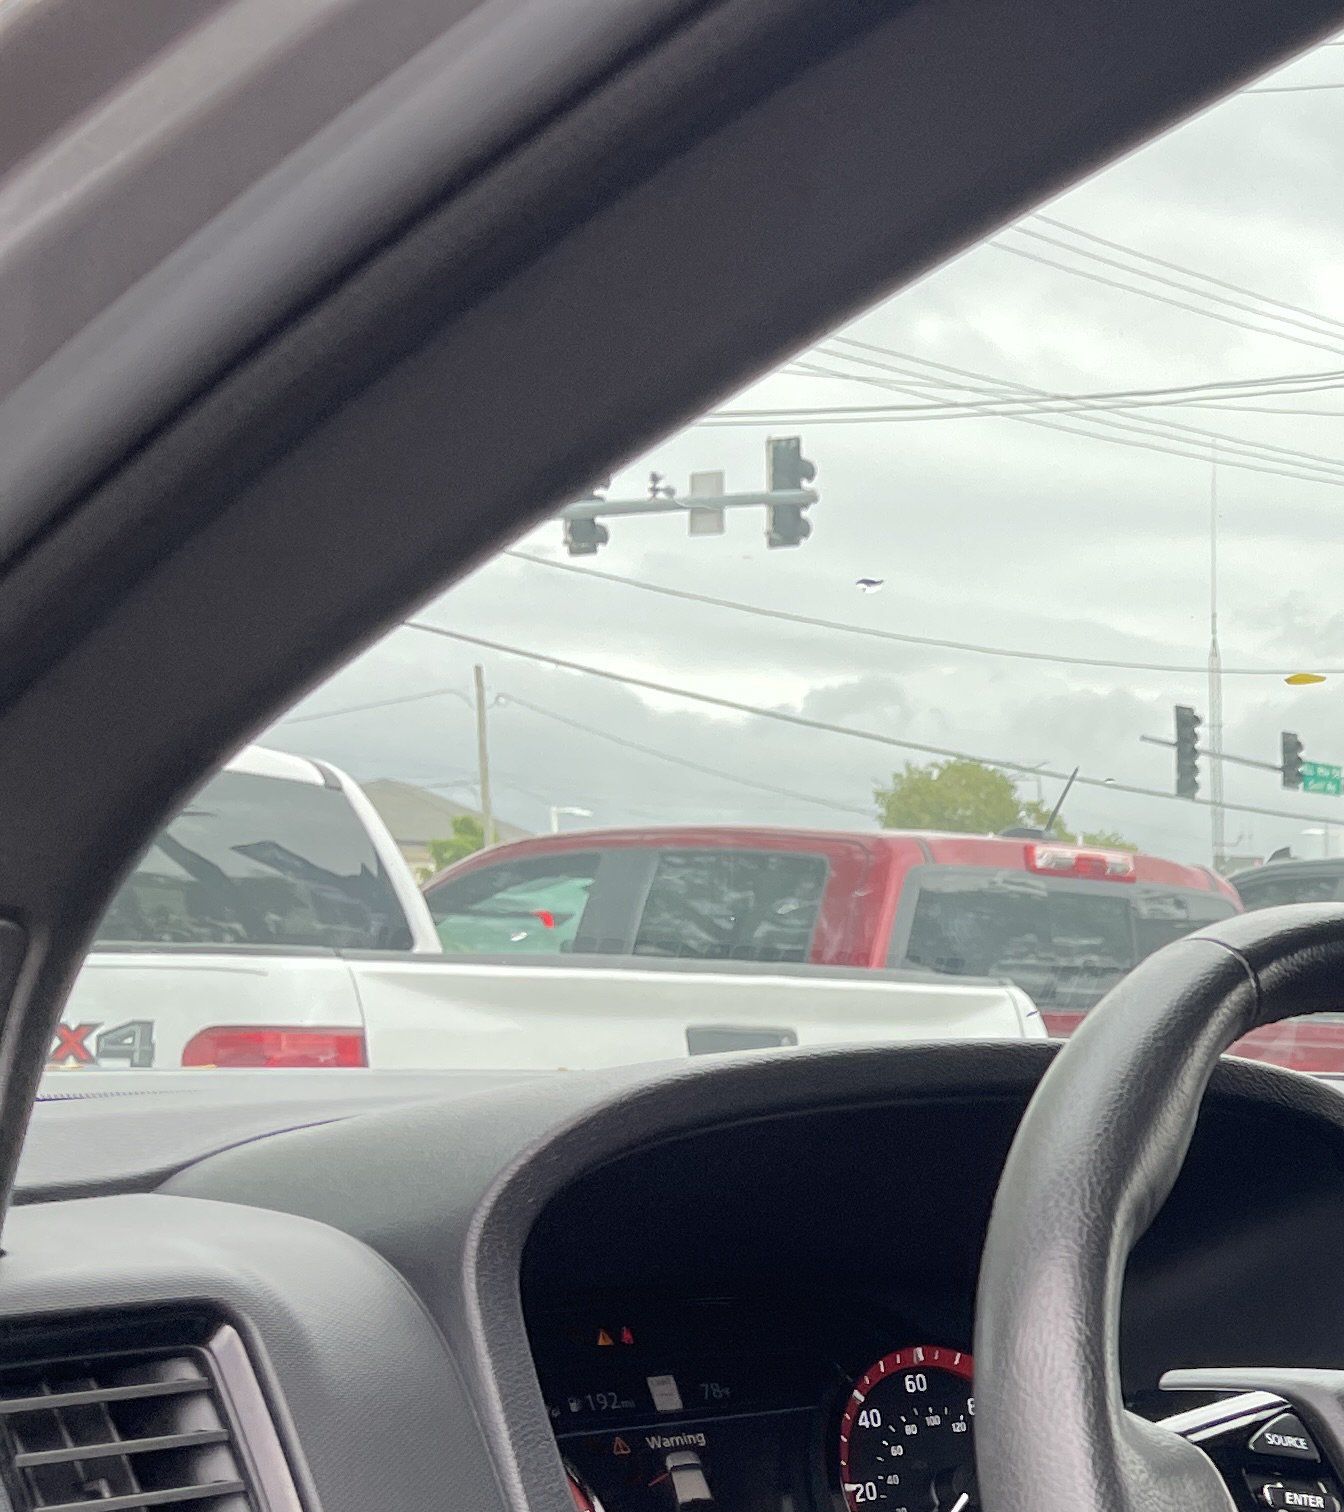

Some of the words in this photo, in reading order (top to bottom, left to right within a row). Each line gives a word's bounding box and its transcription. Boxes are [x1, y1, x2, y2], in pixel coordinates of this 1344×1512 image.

[904, 1373, 927, 1393] 60
[858, 1408, 882, 1429] 40
[951, 1421, 967, 1433] 120
[645, 1432, 706, 1448] Warning
[1264, 1433, 1309, 1450] SOURCE
[890, 1444, 904, 1457] 60
[855, 1482, 878, 1502] 20
[1285, 1491, 1326, 1509] ENTER
